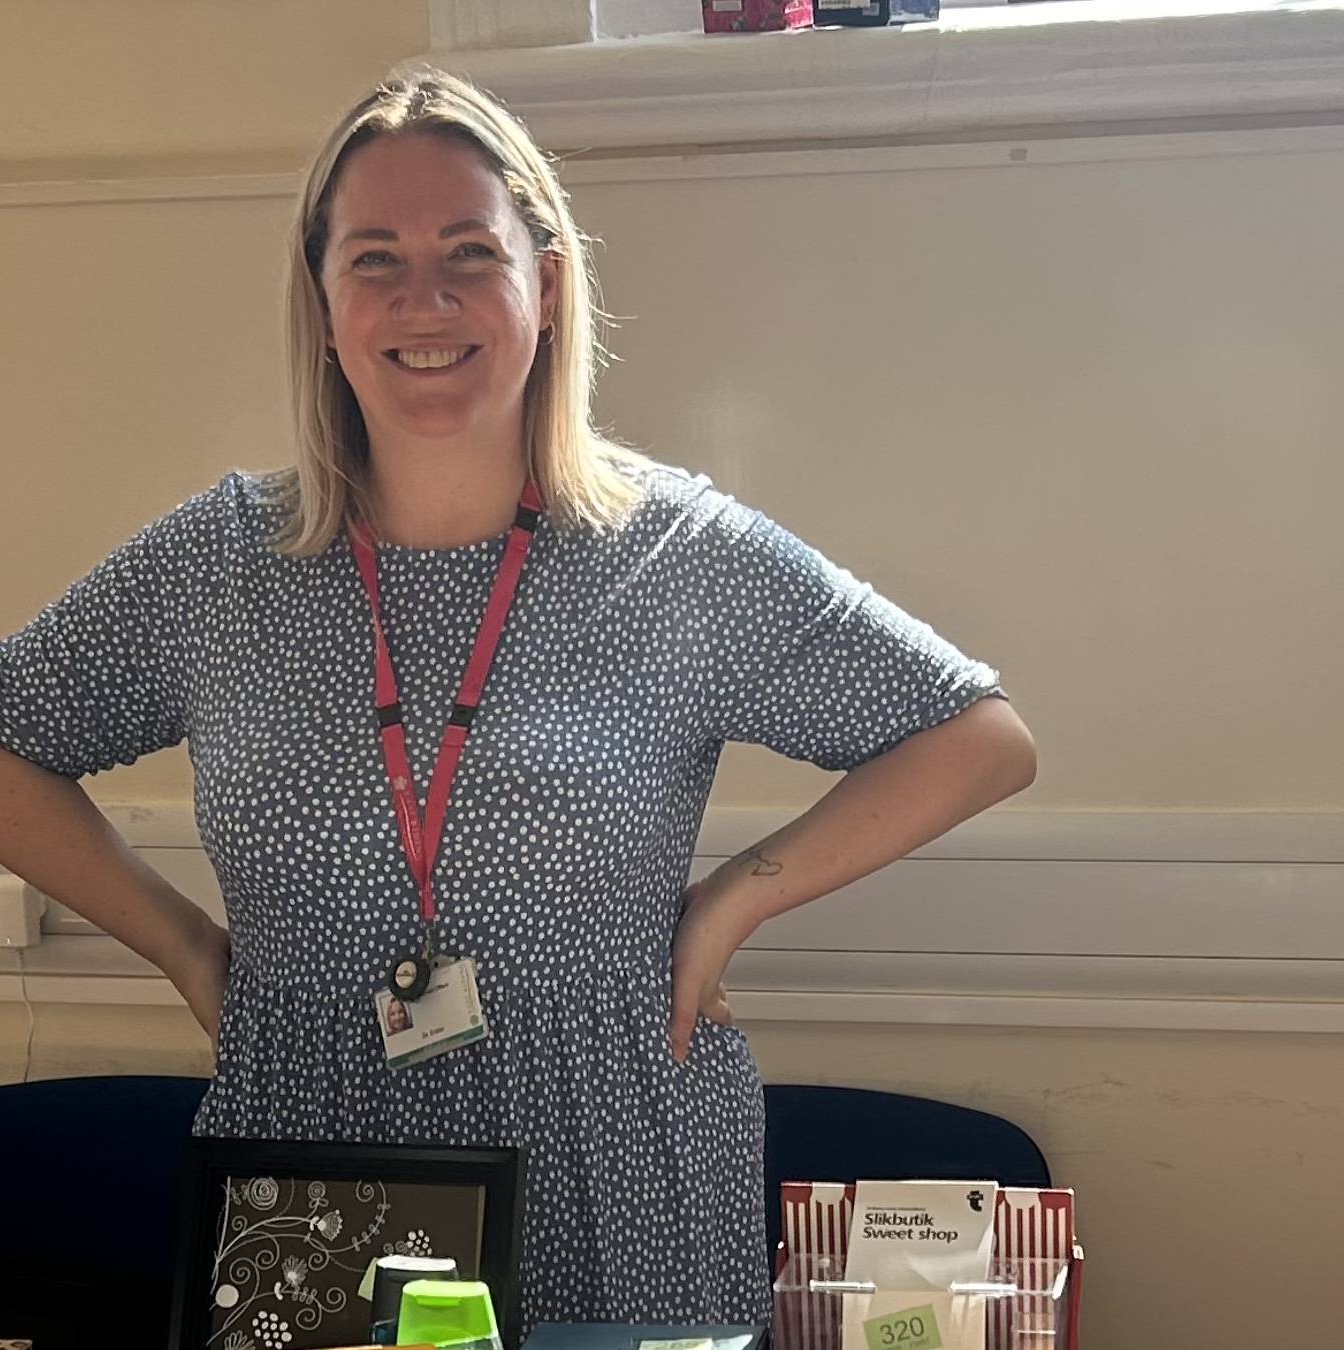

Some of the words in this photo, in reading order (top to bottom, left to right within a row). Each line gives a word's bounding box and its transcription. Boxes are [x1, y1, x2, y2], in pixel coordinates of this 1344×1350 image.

[864, 1212, 935, 1226] Slikbutik
[862, 1226, 914, 1240] Sweet
[918, 1227, 959, 1244] shop
[879, 1316, 925, 1346] 320
